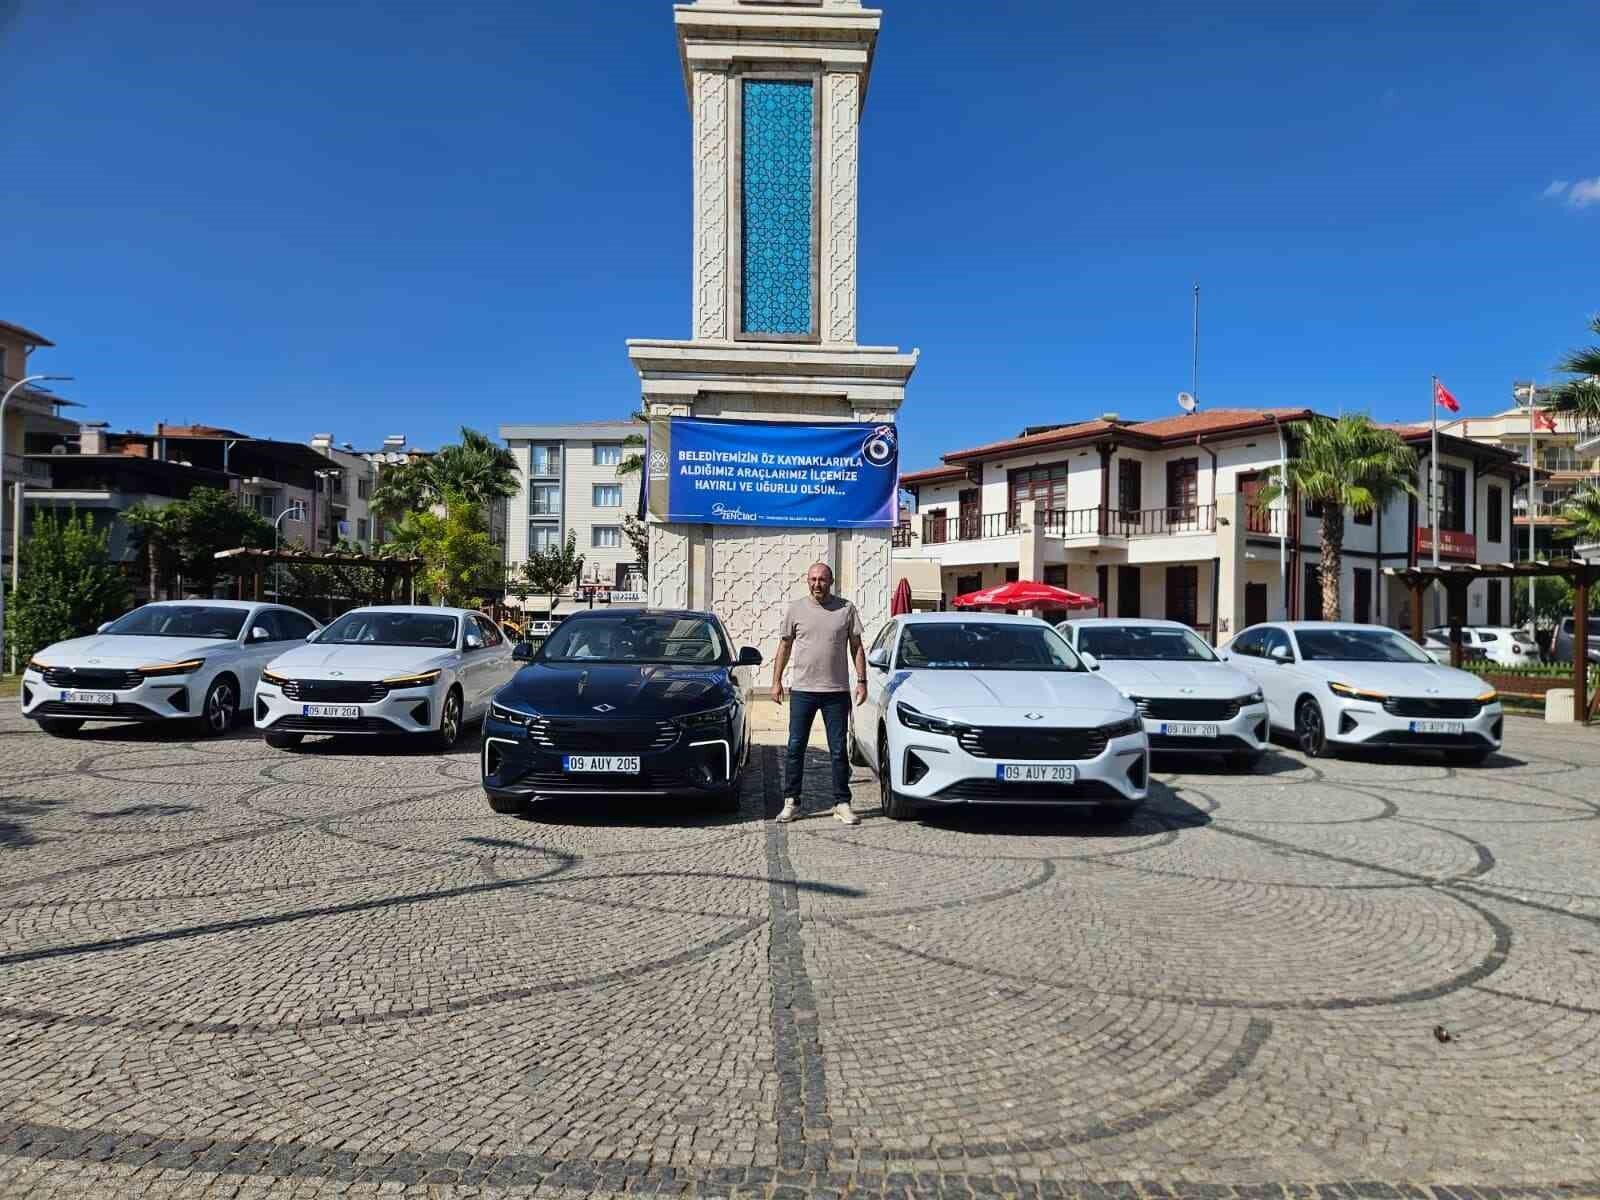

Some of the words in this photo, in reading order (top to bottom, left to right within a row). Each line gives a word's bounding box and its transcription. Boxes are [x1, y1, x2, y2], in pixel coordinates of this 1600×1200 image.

[678, 451, 758, 464] BELEDİYEMİZİN
[761, 452, 775, 464] ÖZ
[777, 453, 863, 467] KAYNAKLARIYLA
[680, 464, 735, 477] ALDIĞIMIZ
[737, 468, 807, 481] ARAÇLARIMIZ
[810, 468, 858, 482] İLÇEMİZE
[695, 480, 736, 491] HAYIRLI
[740, 482, 753, 492] VE
[756, 481, 798, 494] UĞURLU
[800, 485, 846, 495] OLSUN...
[309, 706, 319, 715] 09
[324, 707, 339, 716] AUY
[342, 708, 356, 716] 204
[1182, 726, 1196, 735] AUY
[571, 757, 584, 769] 09
[591, 757, 611, 770] AUY
[617, 758, 638, 770] 205
[1006, 766, 1020, 778] 09
[1026, 767, 1046, 779] AUY
[1052, 767, 1072, 780] 203
